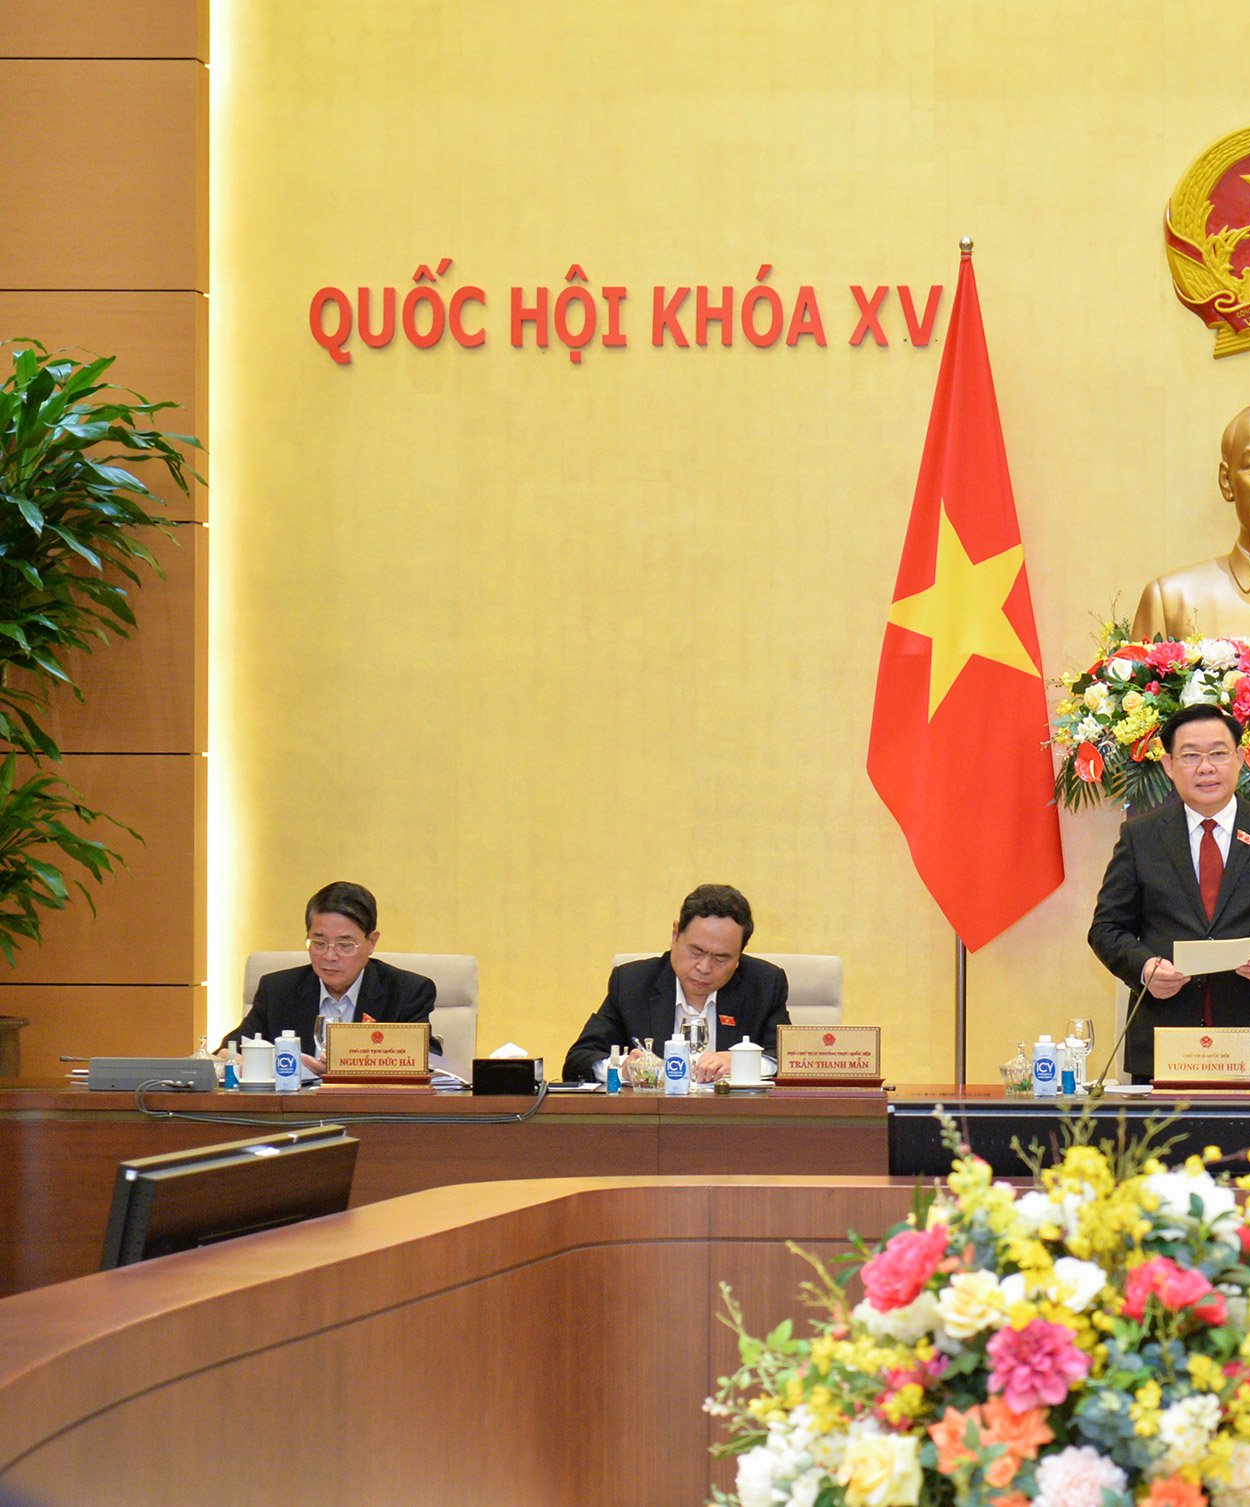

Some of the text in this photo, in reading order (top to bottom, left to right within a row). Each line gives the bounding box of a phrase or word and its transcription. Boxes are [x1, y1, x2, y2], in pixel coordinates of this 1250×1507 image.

[310, 258, 943, 364] QUỐC HỘI KHÓA XV
[277, 1057, 294, 1068] ICY
[667, 1060, 684, 1071] ICY
[1036, 1062, 1053, 1073] ICY
